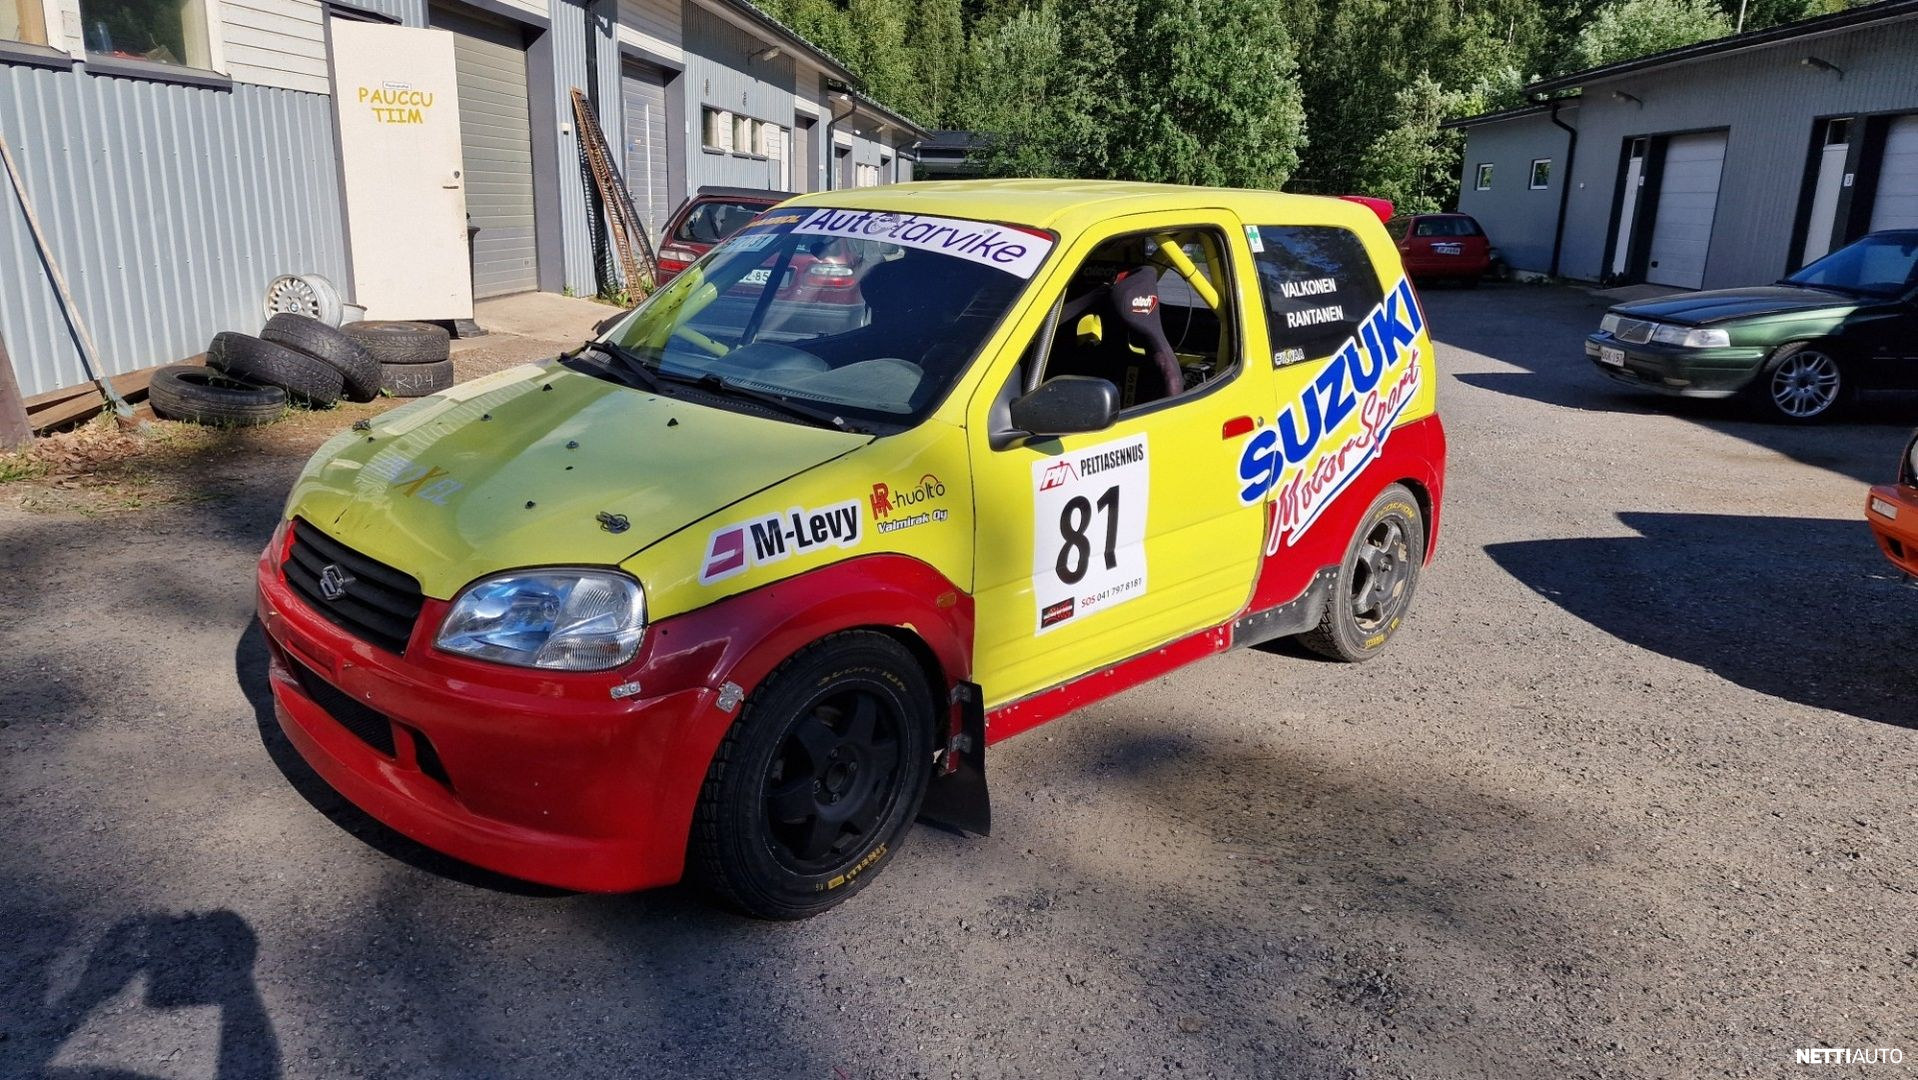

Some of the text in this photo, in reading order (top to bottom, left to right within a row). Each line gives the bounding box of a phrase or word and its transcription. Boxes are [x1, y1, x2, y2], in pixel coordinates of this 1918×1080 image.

[358, 87, 434, 107] PAUCCU
[371, 107, 424, 124] TIIM
[1281, 278, 1337, 298] VALKONEN
[1286, 305, 1344, 328] RANTANEN
[1241, 279, 1422, 502] SUZUKI
[1080, 443, 1144, 477] PELTIASENNUS
[932, 509, 948, 522] Oy
[750, 505, 857, 560] M-Levy
[1055, 485, 1119, 585] 81
[1081, 595, 1096, 608] SOS
[1097, 590, 1110, 602] 041
[1112, 584, 1125, 597] 797
[1125, 577, 1142, 591] 8181
